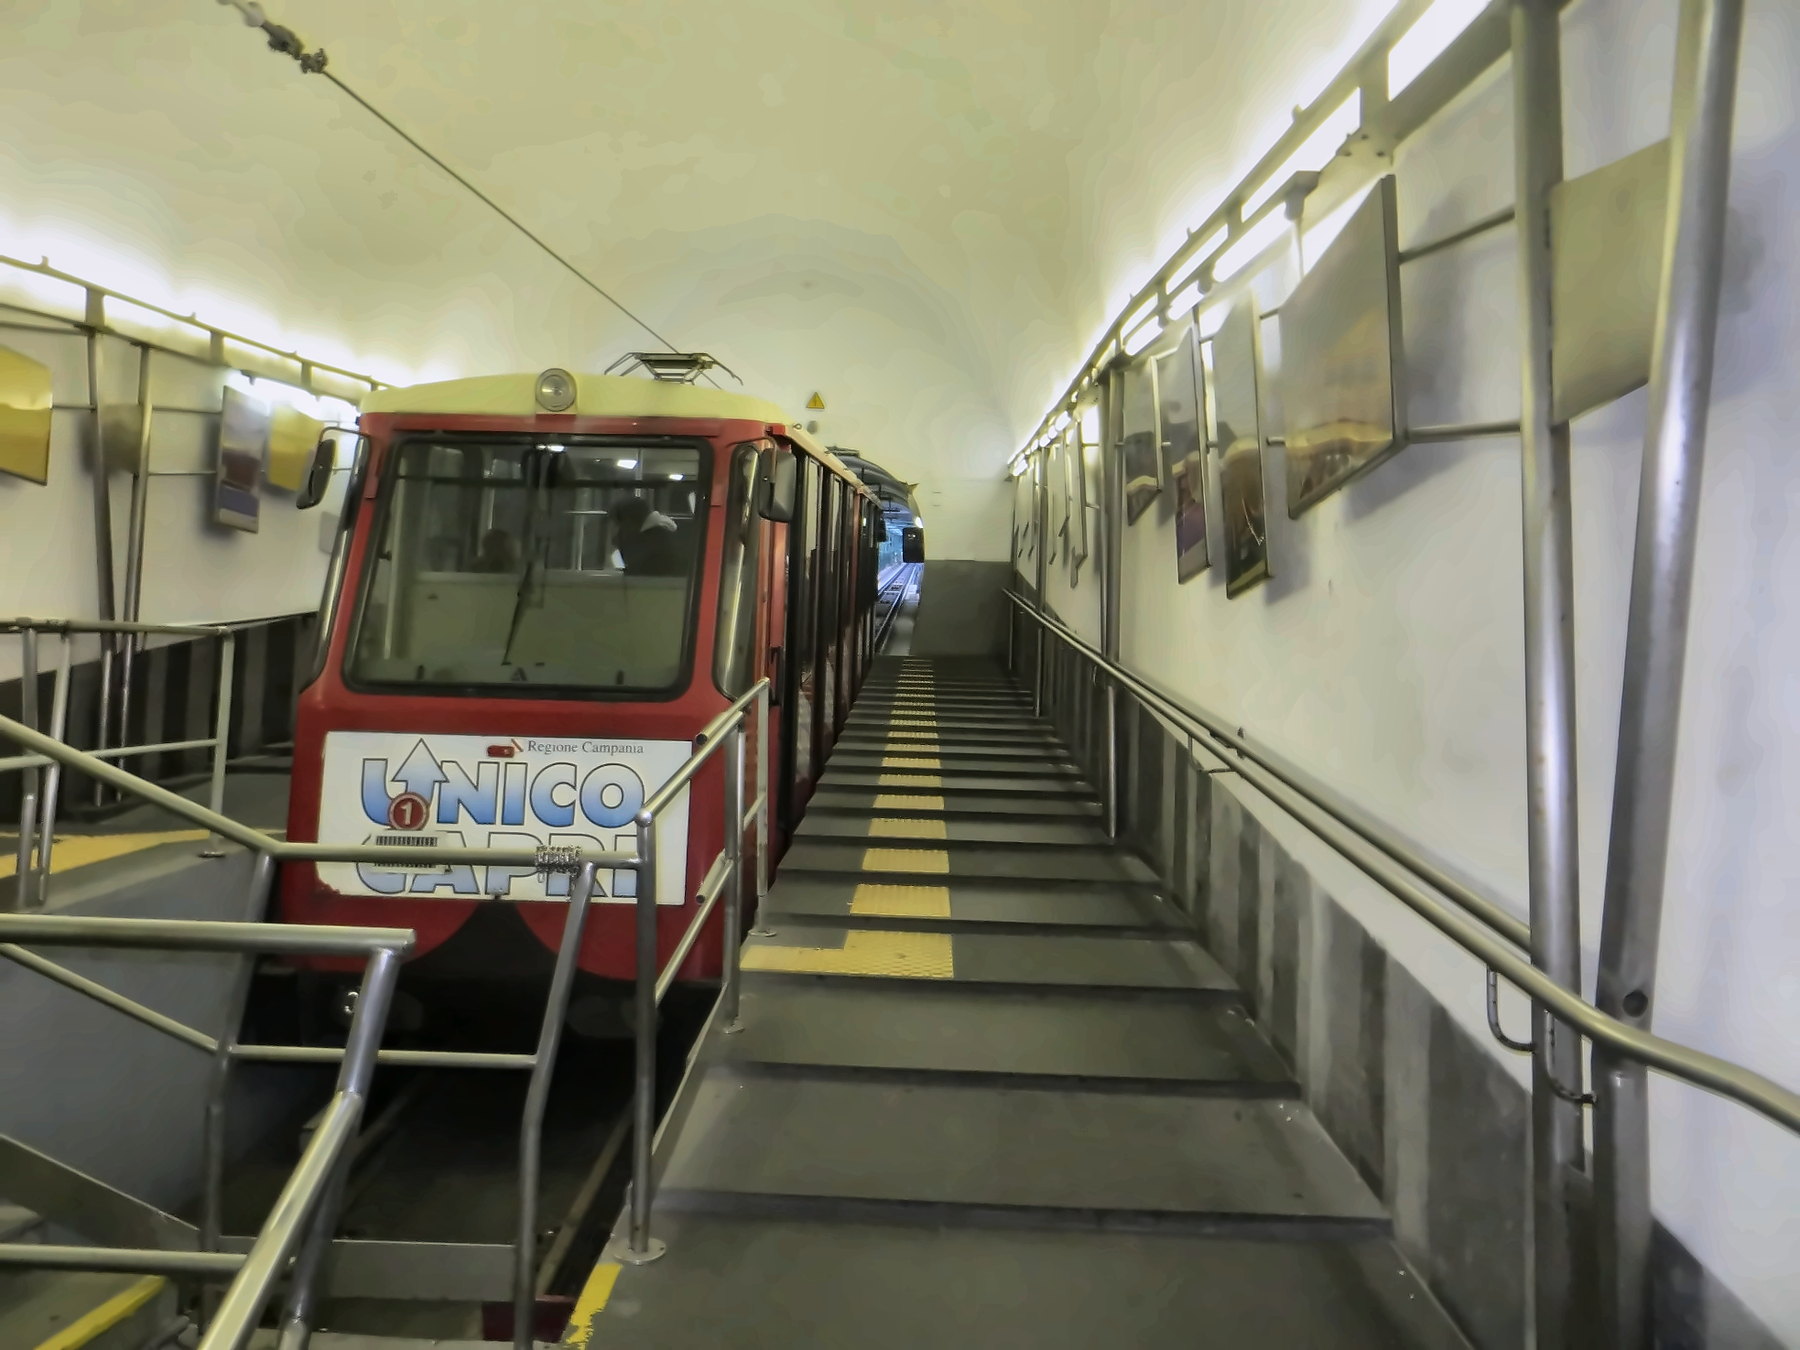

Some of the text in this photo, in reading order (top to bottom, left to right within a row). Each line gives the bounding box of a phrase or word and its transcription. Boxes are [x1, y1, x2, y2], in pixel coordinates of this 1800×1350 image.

[527, 740, 645, 756] Regione Campania
[361, 757, 645, 827] UNICO
[401, 801, 414, 826] 1
